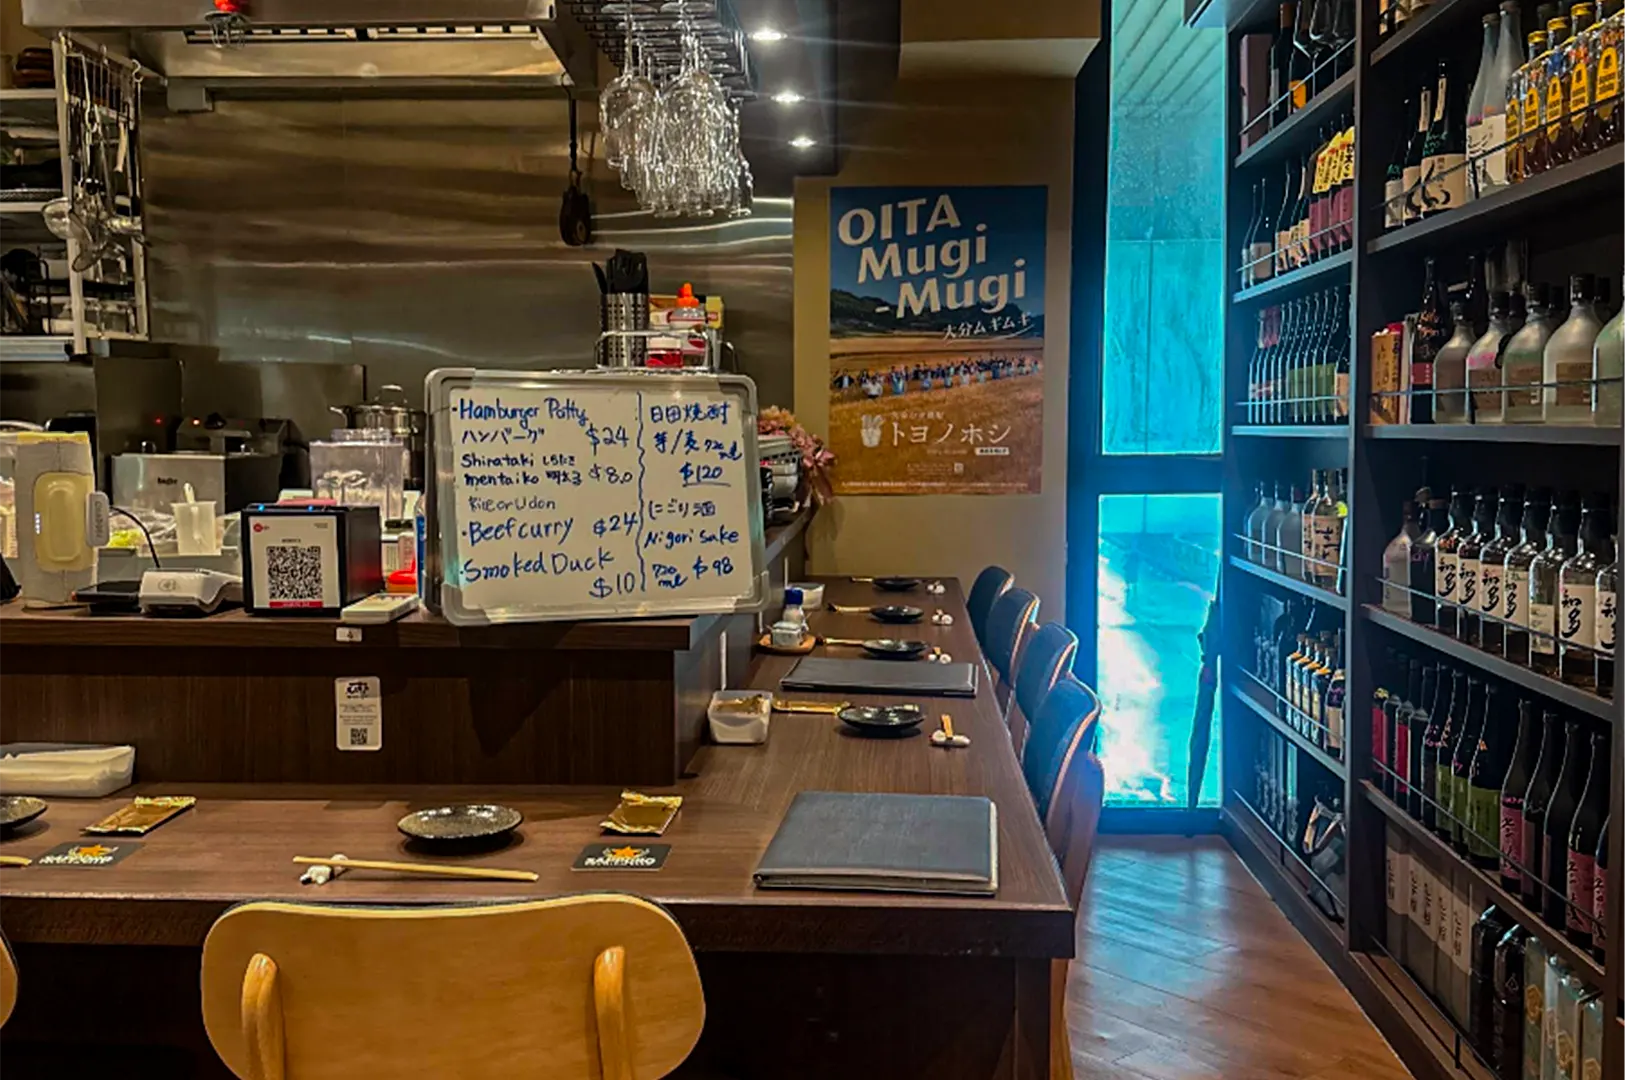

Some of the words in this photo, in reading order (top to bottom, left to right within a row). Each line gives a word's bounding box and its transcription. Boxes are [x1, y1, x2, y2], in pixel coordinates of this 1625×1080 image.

[838, 194, 961, 246] OITA
[857, 223, 987, 284] Mugi
[459, 398, 540, 430] Hamburger
[585, 422, 630, 456] $24
[891, 422, 1013, 447] トヨノホシ
[464, 471, 540, 487] mentaiko
[679, 461, 724, 484] $120
[468, 516, 517, 547] Beef
[517, 516, 574, 546] curry
[592, 511, 638, 538] $24
[463, 551, 548, 583] Smoked
[551, 546, 615, 577] Duck
[588, 571, 636, 599] $10
